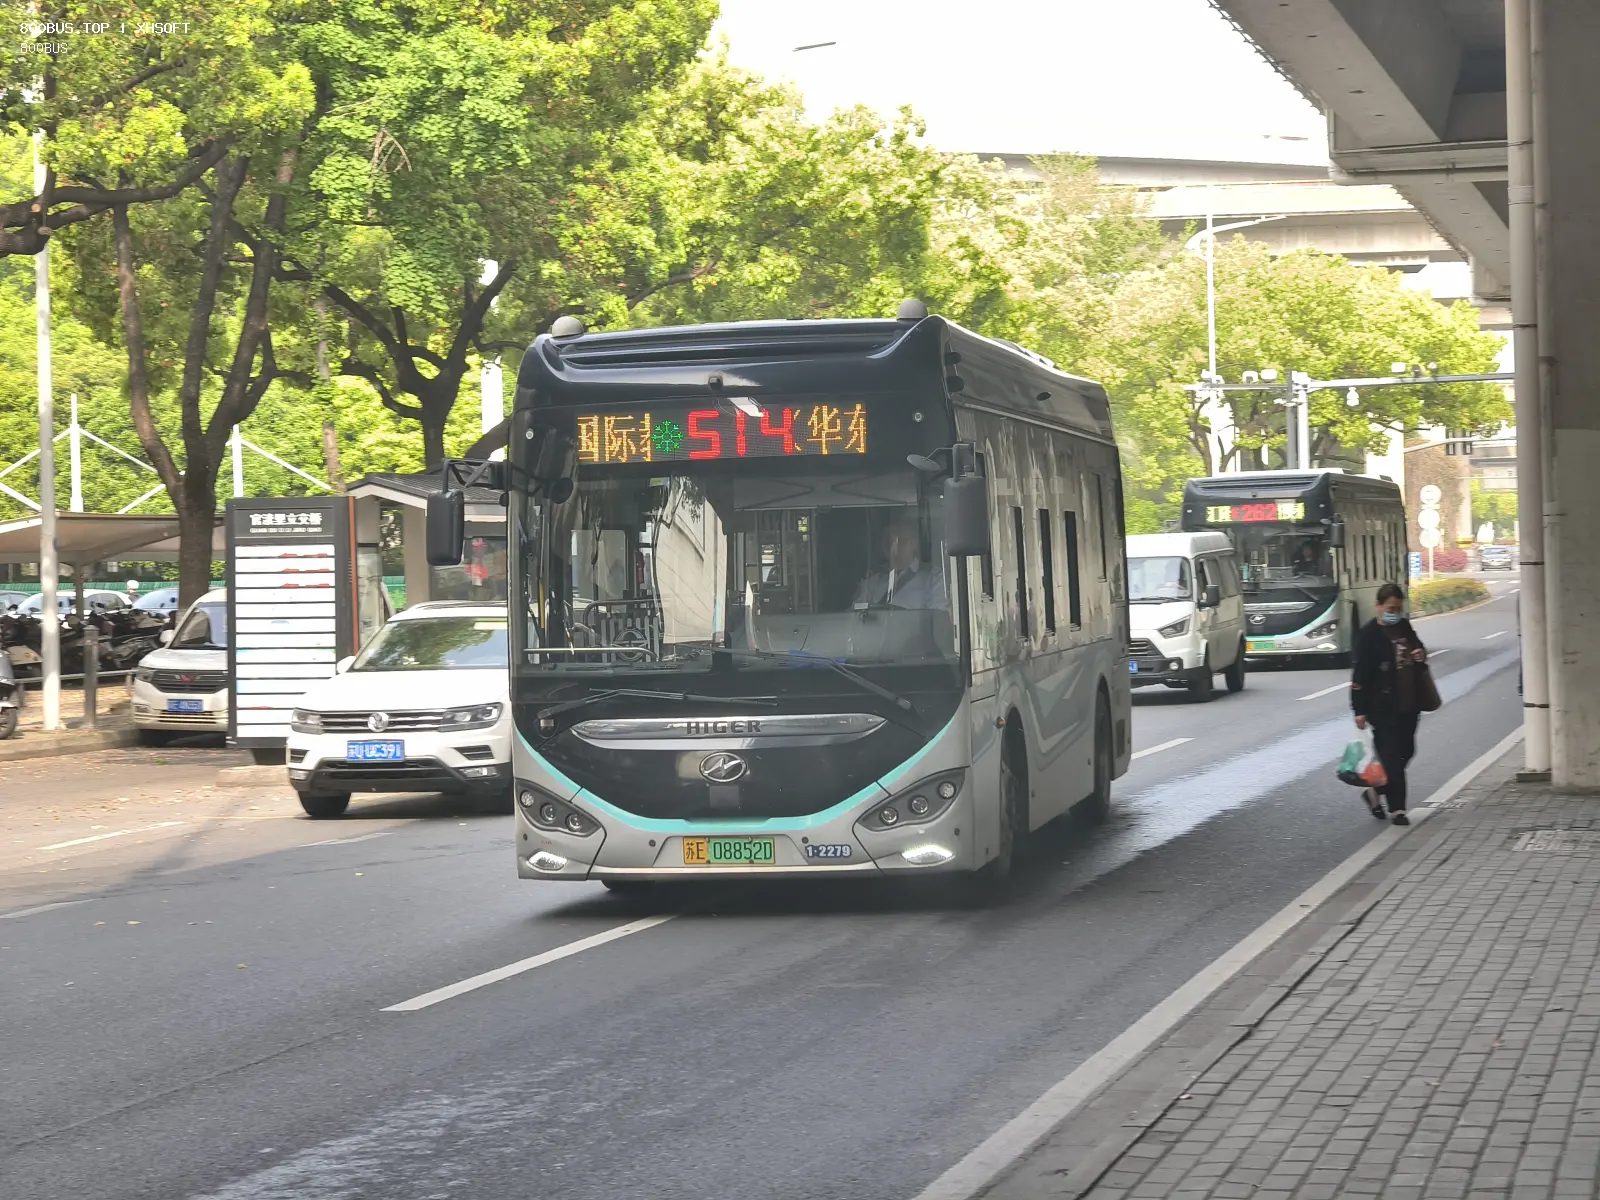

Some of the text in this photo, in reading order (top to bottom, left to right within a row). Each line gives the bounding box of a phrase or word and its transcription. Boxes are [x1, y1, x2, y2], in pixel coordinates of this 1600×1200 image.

[687, 407, 793, 460] 514
[1241, 503, 1278, 522] 262
[686, 720, 762, 735] HIGER
